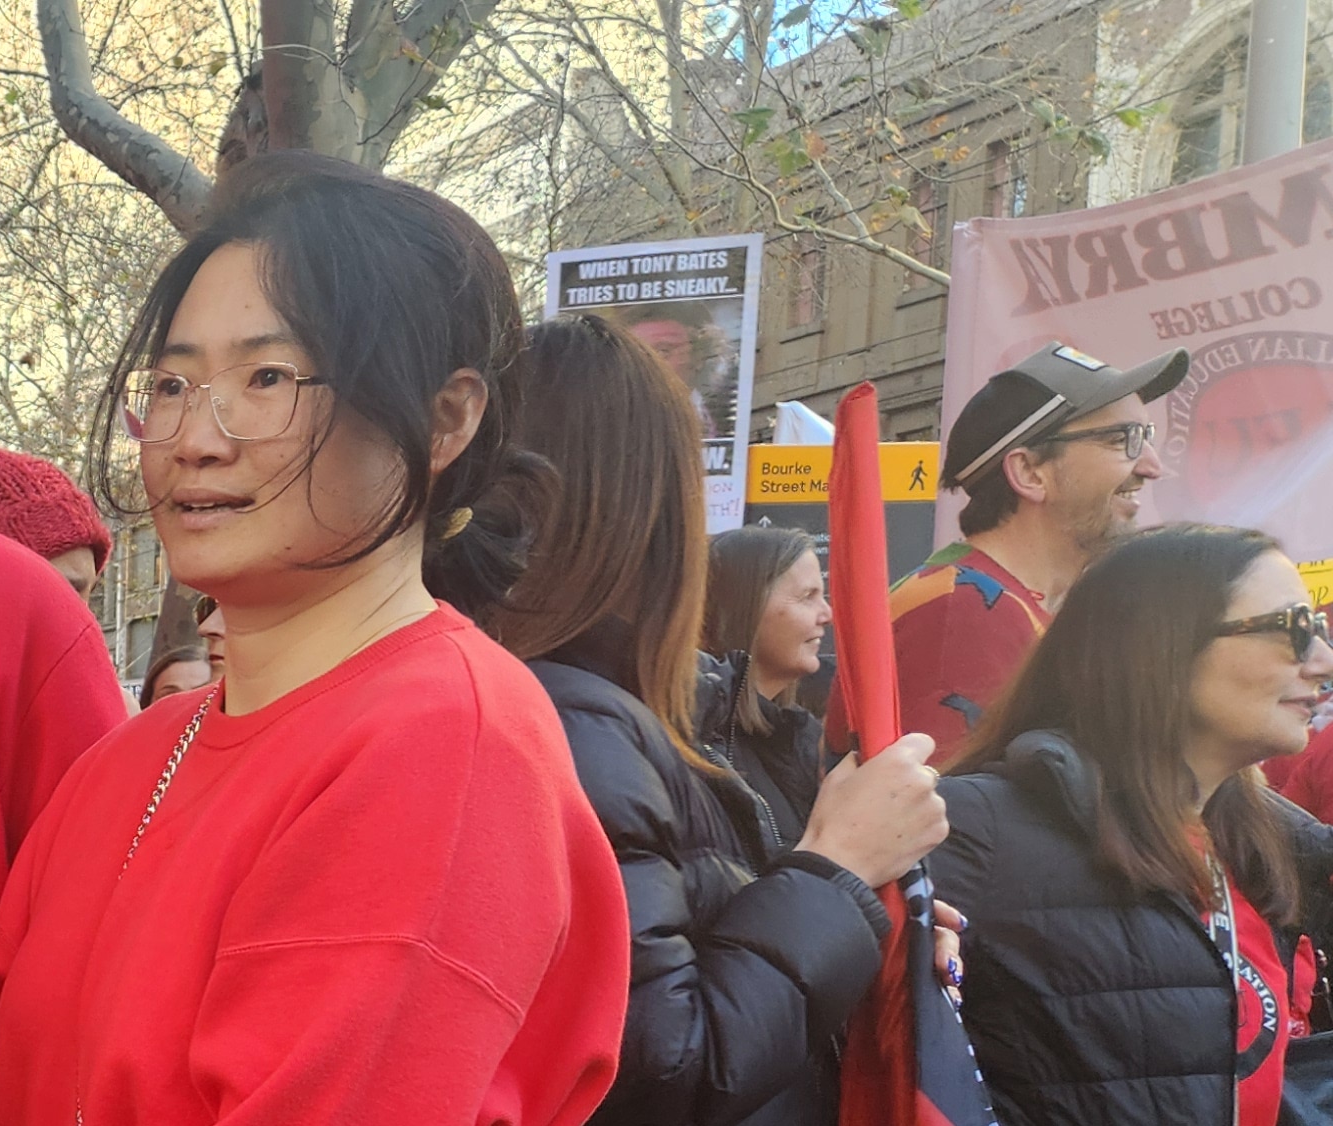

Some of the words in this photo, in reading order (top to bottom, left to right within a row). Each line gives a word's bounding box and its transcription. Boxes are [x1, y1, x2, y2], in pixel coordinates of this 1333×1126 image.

[579, 262, 628, 280] WHEN
[630, 255, 675, 275] TONY
[677, 251, 728, 271] BATES
[566, 284, 614, 305] TRIES
[616, 283, 639, 300] TO
[640, 281, 662, 298] BE
[761, 462, 812, 475] Bourke
[760, 480, 806, 493] Street
[809, 479, 830, 492] Ma
